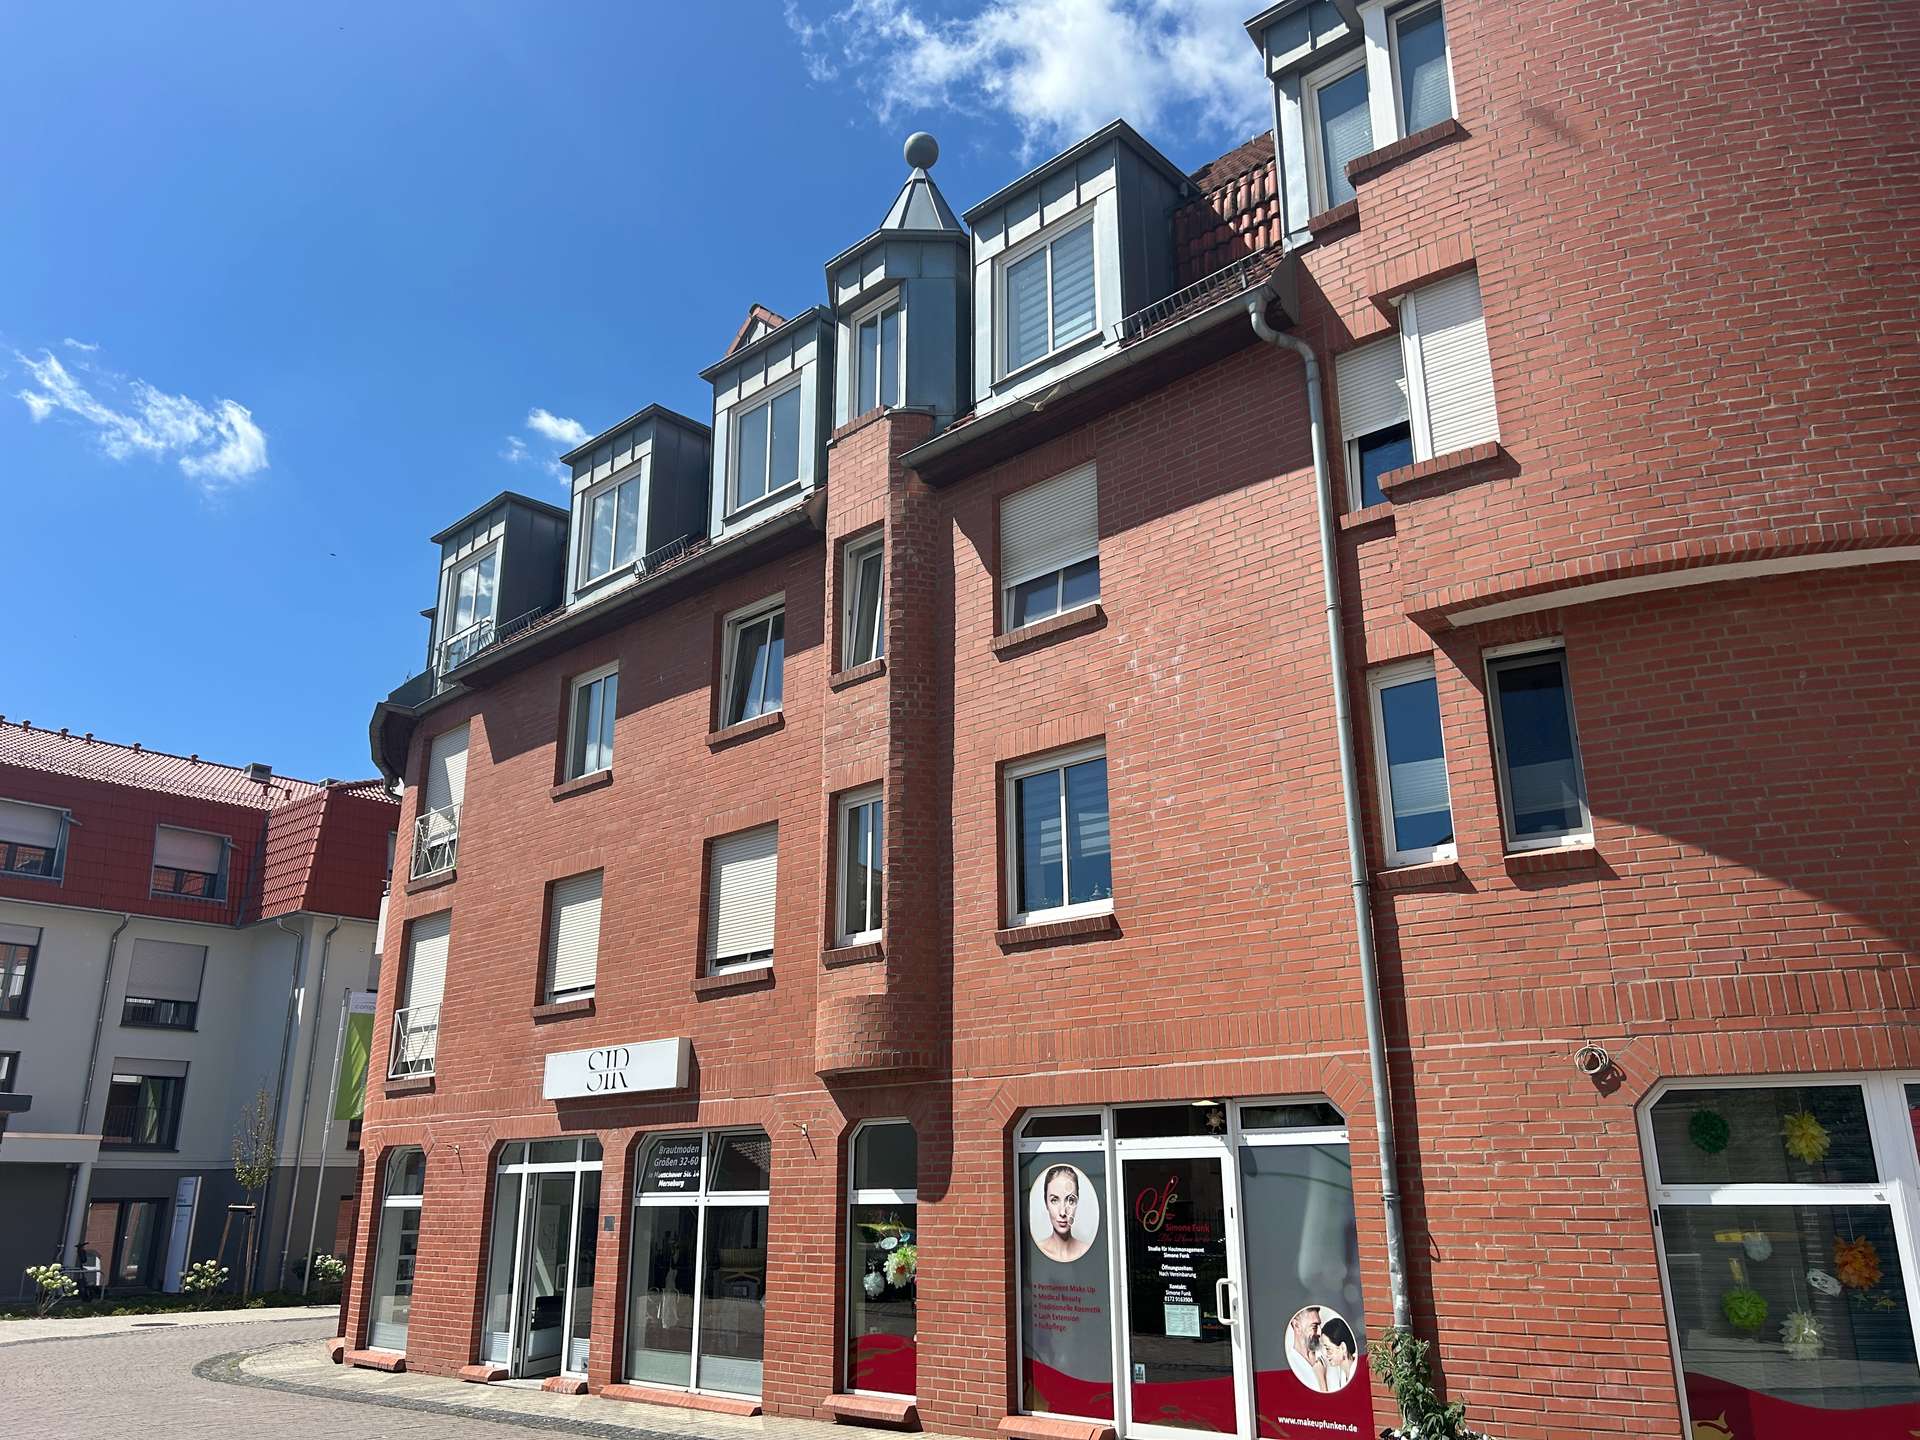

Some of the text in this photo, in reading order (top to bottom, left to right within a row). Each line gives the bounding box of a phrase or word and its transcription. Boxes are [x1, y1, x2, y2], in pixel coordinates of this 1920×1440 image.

[658, 1144, 700, 1155] Brautmoden
[654, 1156, 699, 1167] Größen 32-60
